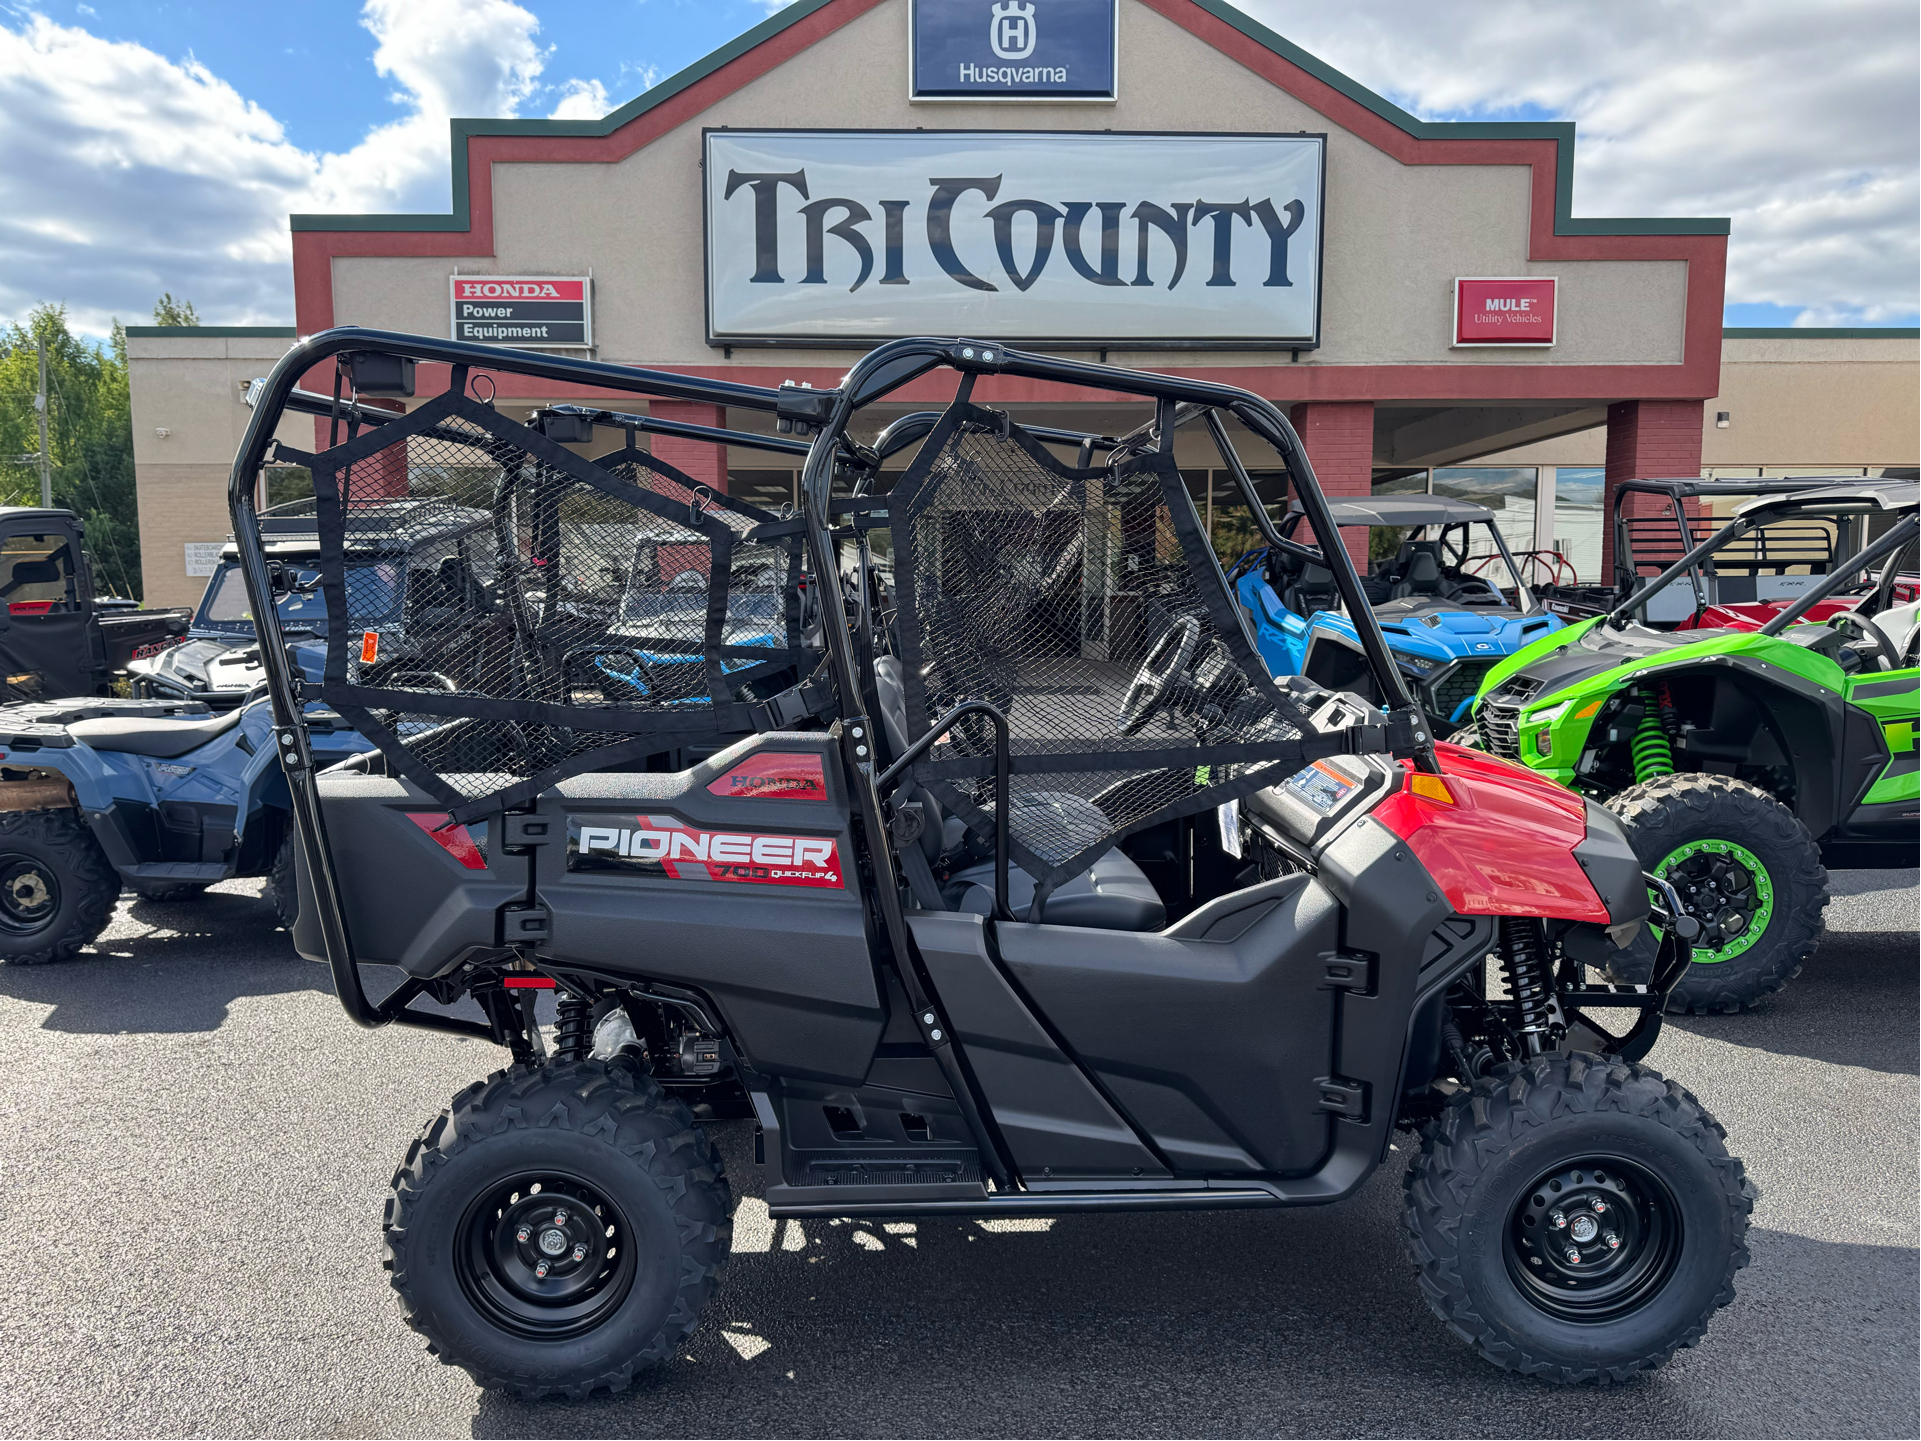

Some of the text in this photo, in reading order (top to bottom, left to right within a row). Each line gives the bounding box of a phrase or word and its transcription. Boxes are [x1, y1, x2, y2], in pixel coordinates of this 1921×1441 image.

[959, 62, 1067, 87] Husqvarna
[928, 172, 1307, 293] COUNTY
[462, 283, 560, 297] HONDA
[462, 304, 514, 318] Power
[1474, 313, 1542, 326] Utility Vehicles
[463, 324, 549, 340] Equipment
[1258, 622, 1304, 658] RZR
[730, 775, 820, 791] HONDA
[578, 826, 833, 868] PIONEER
[713, 864, 771, 879] 700
[1470, 1160, 1523, 1258] KENDA
[453, 1330, 560, 1380] KENDA
